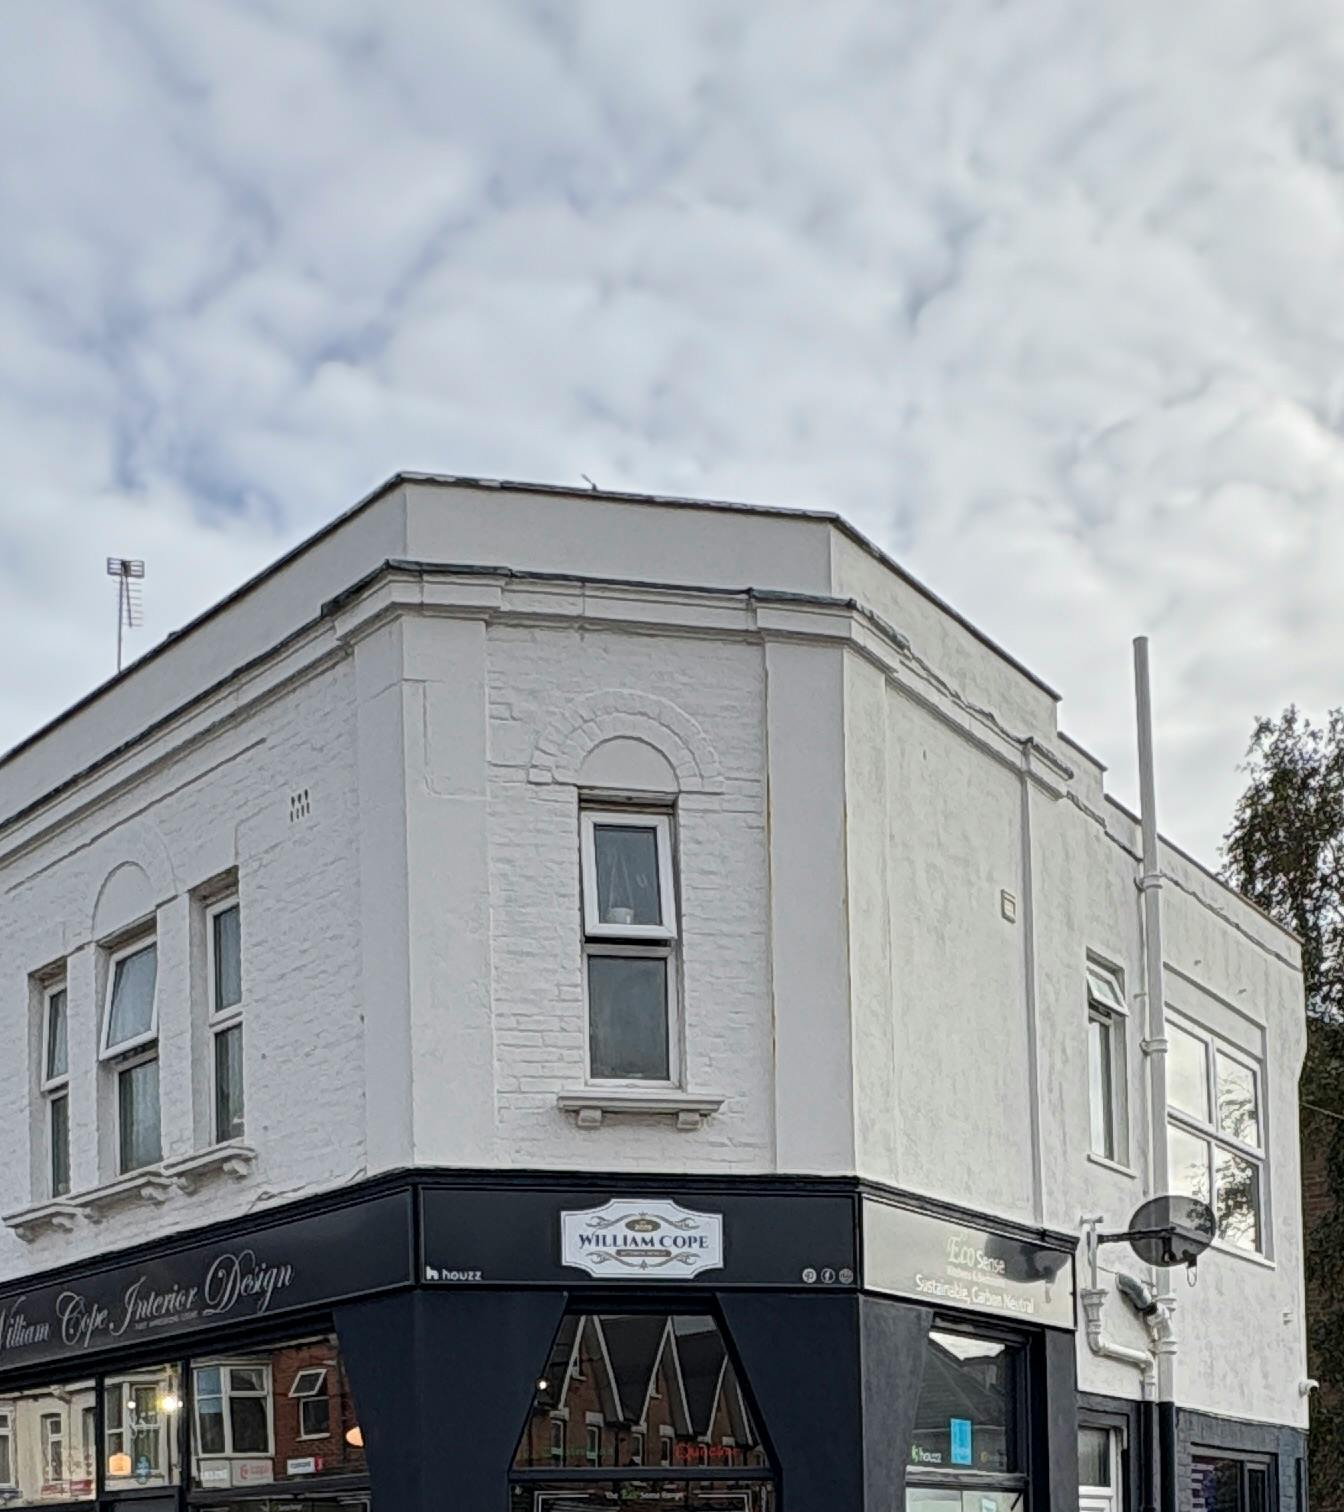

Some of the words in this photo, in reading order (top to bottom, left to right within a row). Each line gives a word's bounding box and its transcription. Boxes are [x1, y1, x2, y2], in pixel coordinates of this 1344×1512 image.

[579, 1233, 655, 1249] WILLIAM
[659, 1234, 709, 1249] COPE
[947, 1235, 976, 1267] Eco
[976, 1250, 1005, 1273] Sense
[442, 1268, 482, 1280] houzz
[56, 1291, 107, 1348] Cope
[109, 1276, 198, 1336] Interior
[203, 1249, 294, 1315] Design
[971, 1287, 1002, 1307] Carbon
